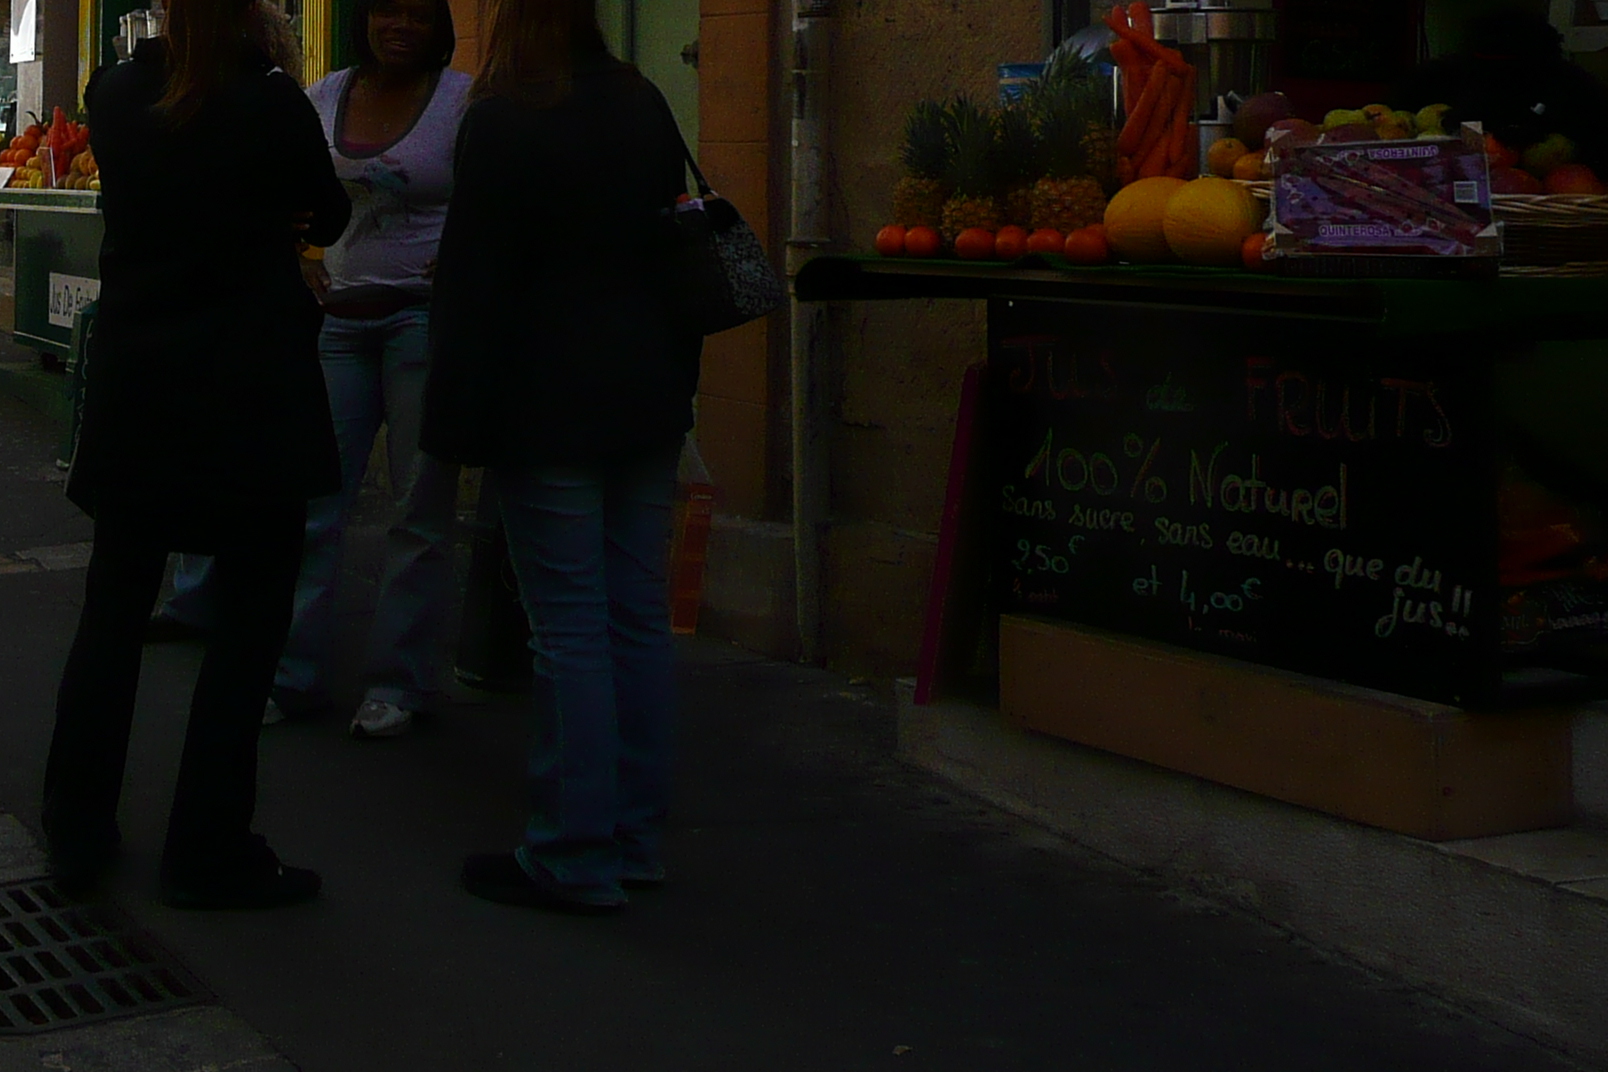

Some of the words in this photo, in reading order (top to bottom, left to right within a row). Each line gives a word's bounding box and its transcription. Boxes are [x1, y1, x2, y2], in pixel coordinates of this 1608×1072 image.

[1318, 224, 1391, 238] QUINTEROSA
[1024, 425, 1169, 506] 100%
[1132, 563, 1163, 597] et
[1153, 516, 1214, 551] sans
[1324, 548, 1385, 590] que
[1394, 555, 1444, 593] du
